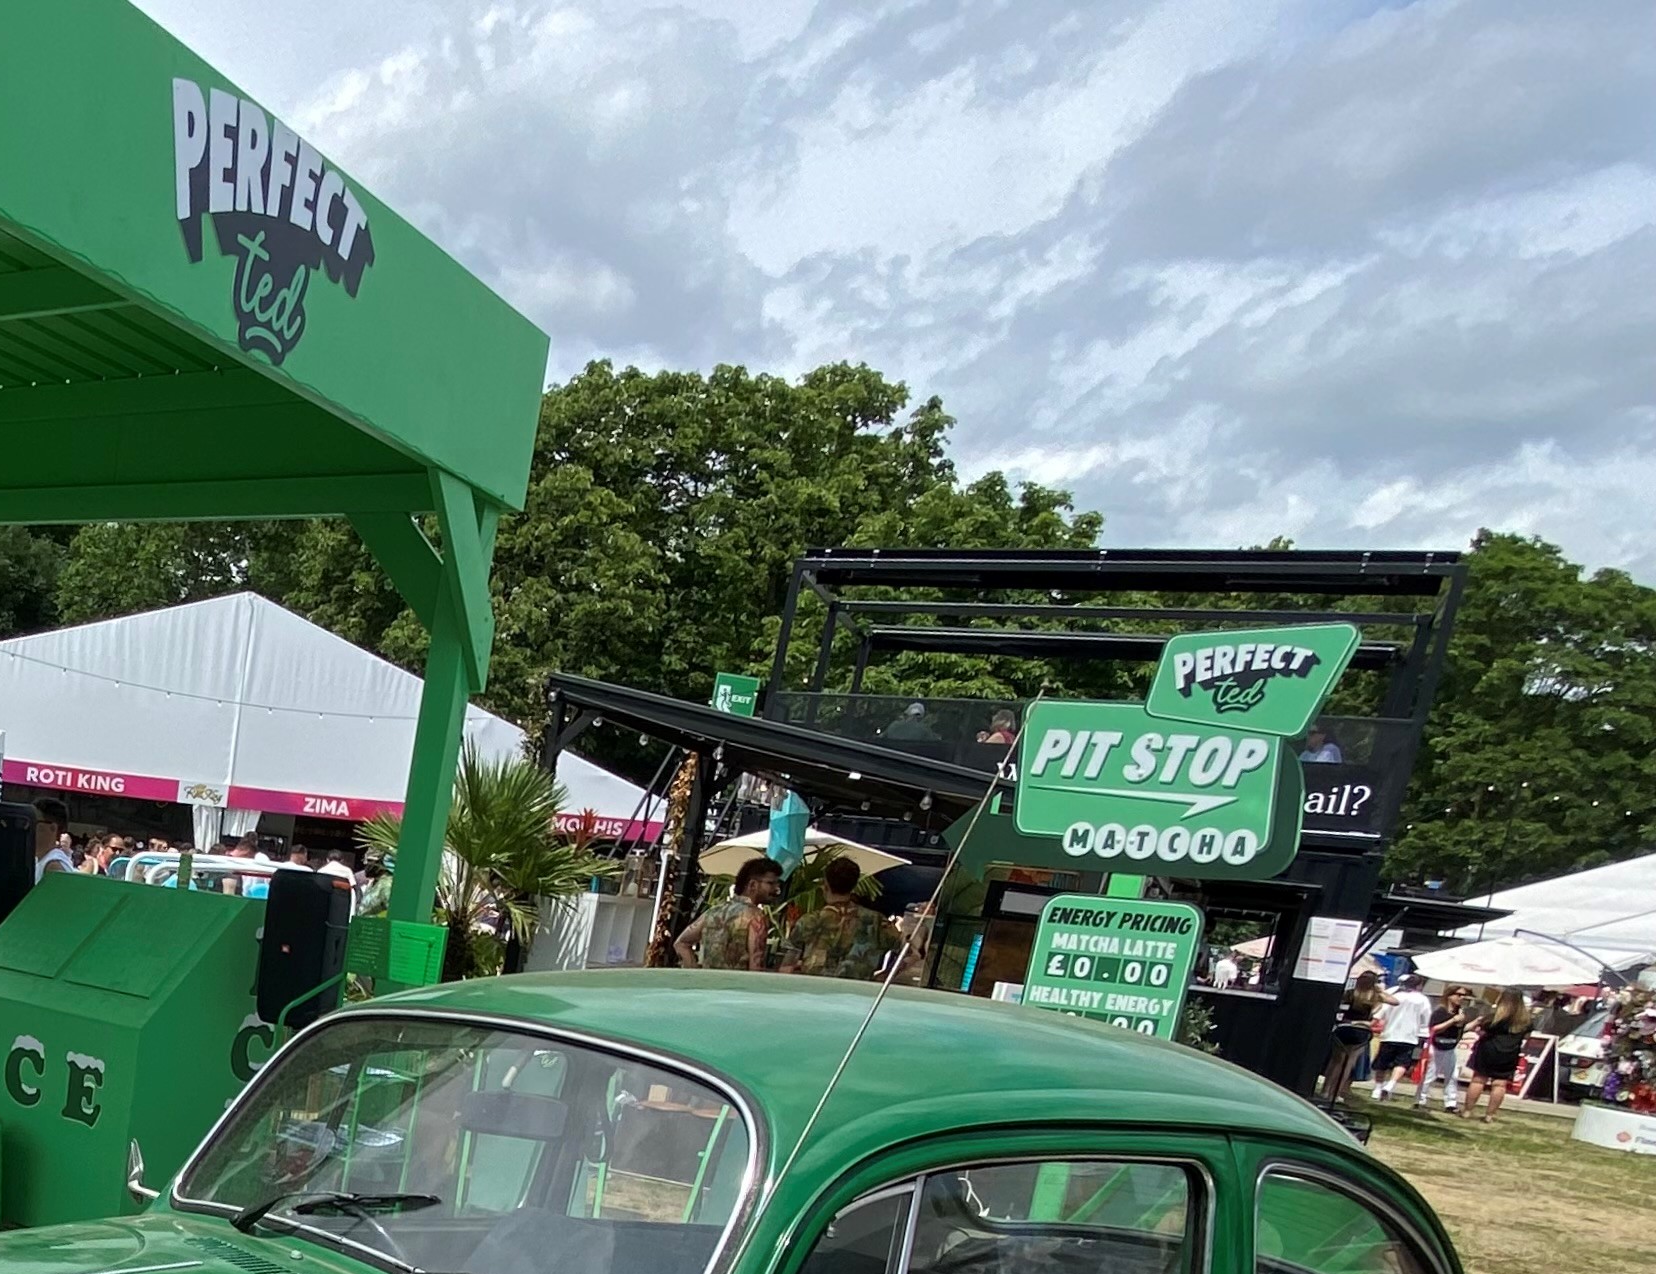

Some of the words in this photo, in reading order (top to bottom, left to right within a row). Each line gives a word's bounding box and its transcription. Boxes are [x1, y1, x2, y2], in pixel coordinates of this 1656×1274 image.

[172, 77, 368, 262] PERFECT
[237, 230, 306, 341] ted
[1174, 643, 1314, 690] PERFECT
[731, 694, 752, 705] EXIT
[1214, 677, 1266, 704] ted
[1030, 728, 1123, 779] PIT
[1122, 732, 1269, 788] STOP
[26, 766, 72, 787] ROTI
[77, 775, 125, 793] KING
[303, 796, 350, 817] ZIMA
[1303, 784, 1372, 817] ail?
[551, 816, 624, 836] MOHIS
[1066, 826, 1249, 859] MATCHA
[1047, 906, 1118, 929] ENERGY
[1117, 912, 1193, 936] PRICING
[1051, 931, 1120, 955] MATCHA
[1122, 938, 1178, 960] LATTE
[1047, 954, 1168, 986] £0.00
[1029, 984, 1104, 1009] HEALTHY
[1104, 993, 1176, 1017] ENERGY
